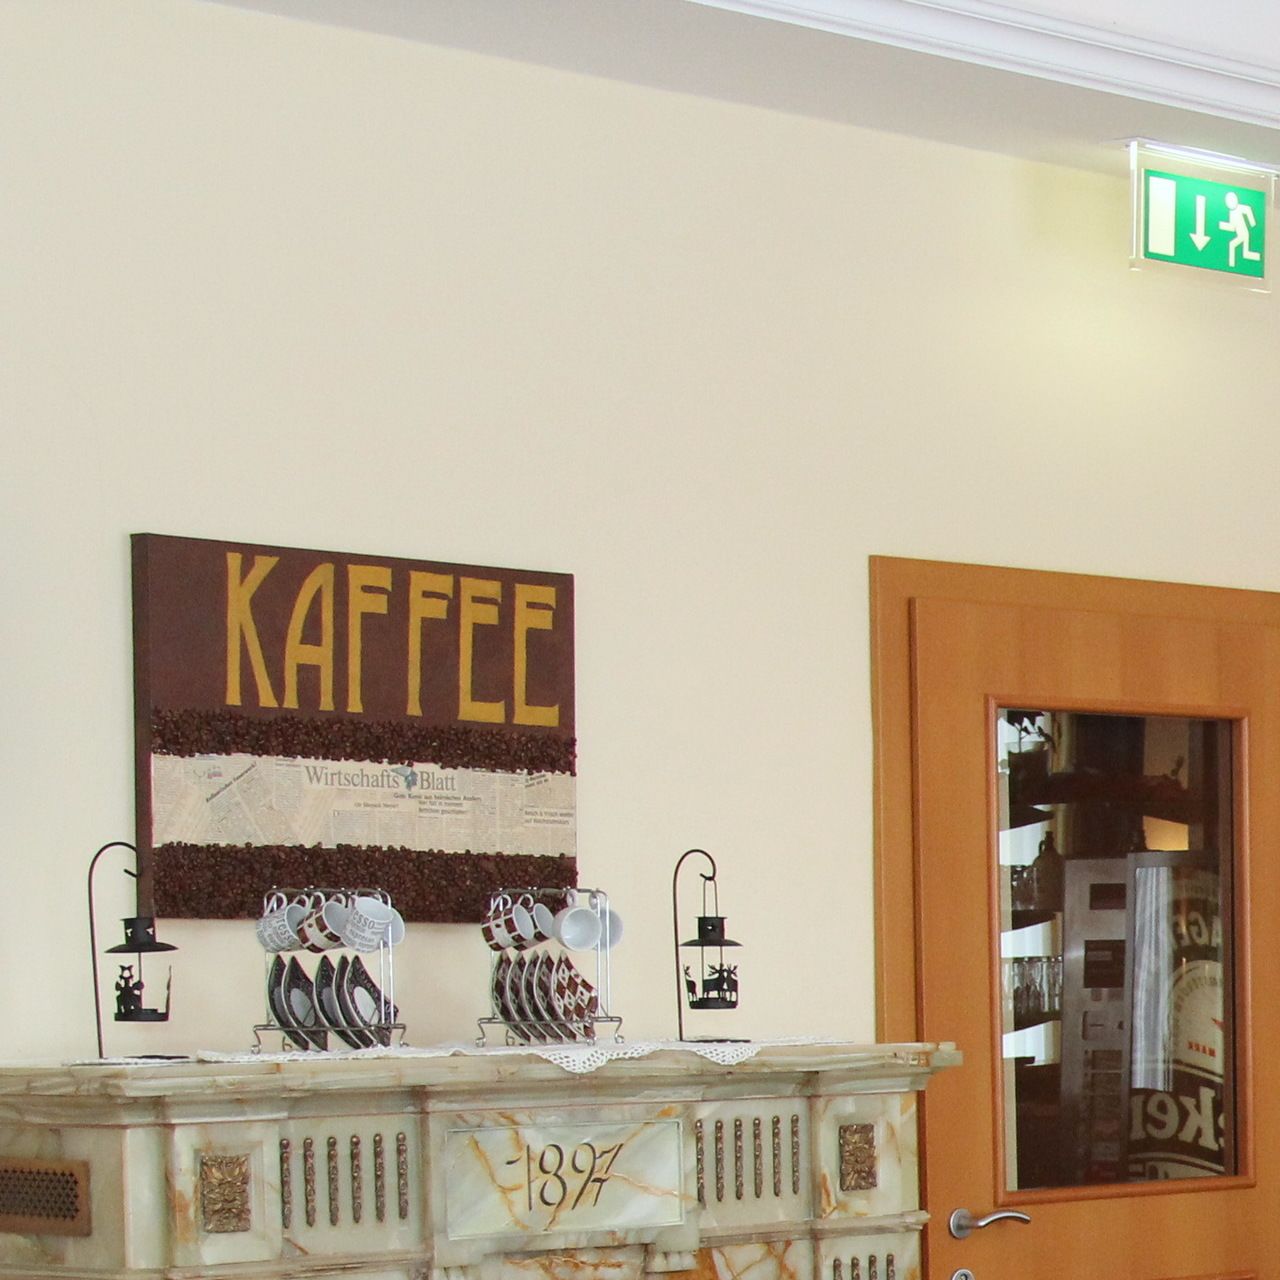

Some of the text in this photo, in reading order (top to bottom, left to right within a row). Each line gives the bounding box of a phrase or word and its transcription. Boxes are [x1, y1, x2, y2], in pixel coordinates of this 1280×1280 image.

[226, 551, 559, 727] KAFFEE
[304, 765, 456, 791] Wirtschafts Blatt
[506, 1142, 624, 1211] 1897
